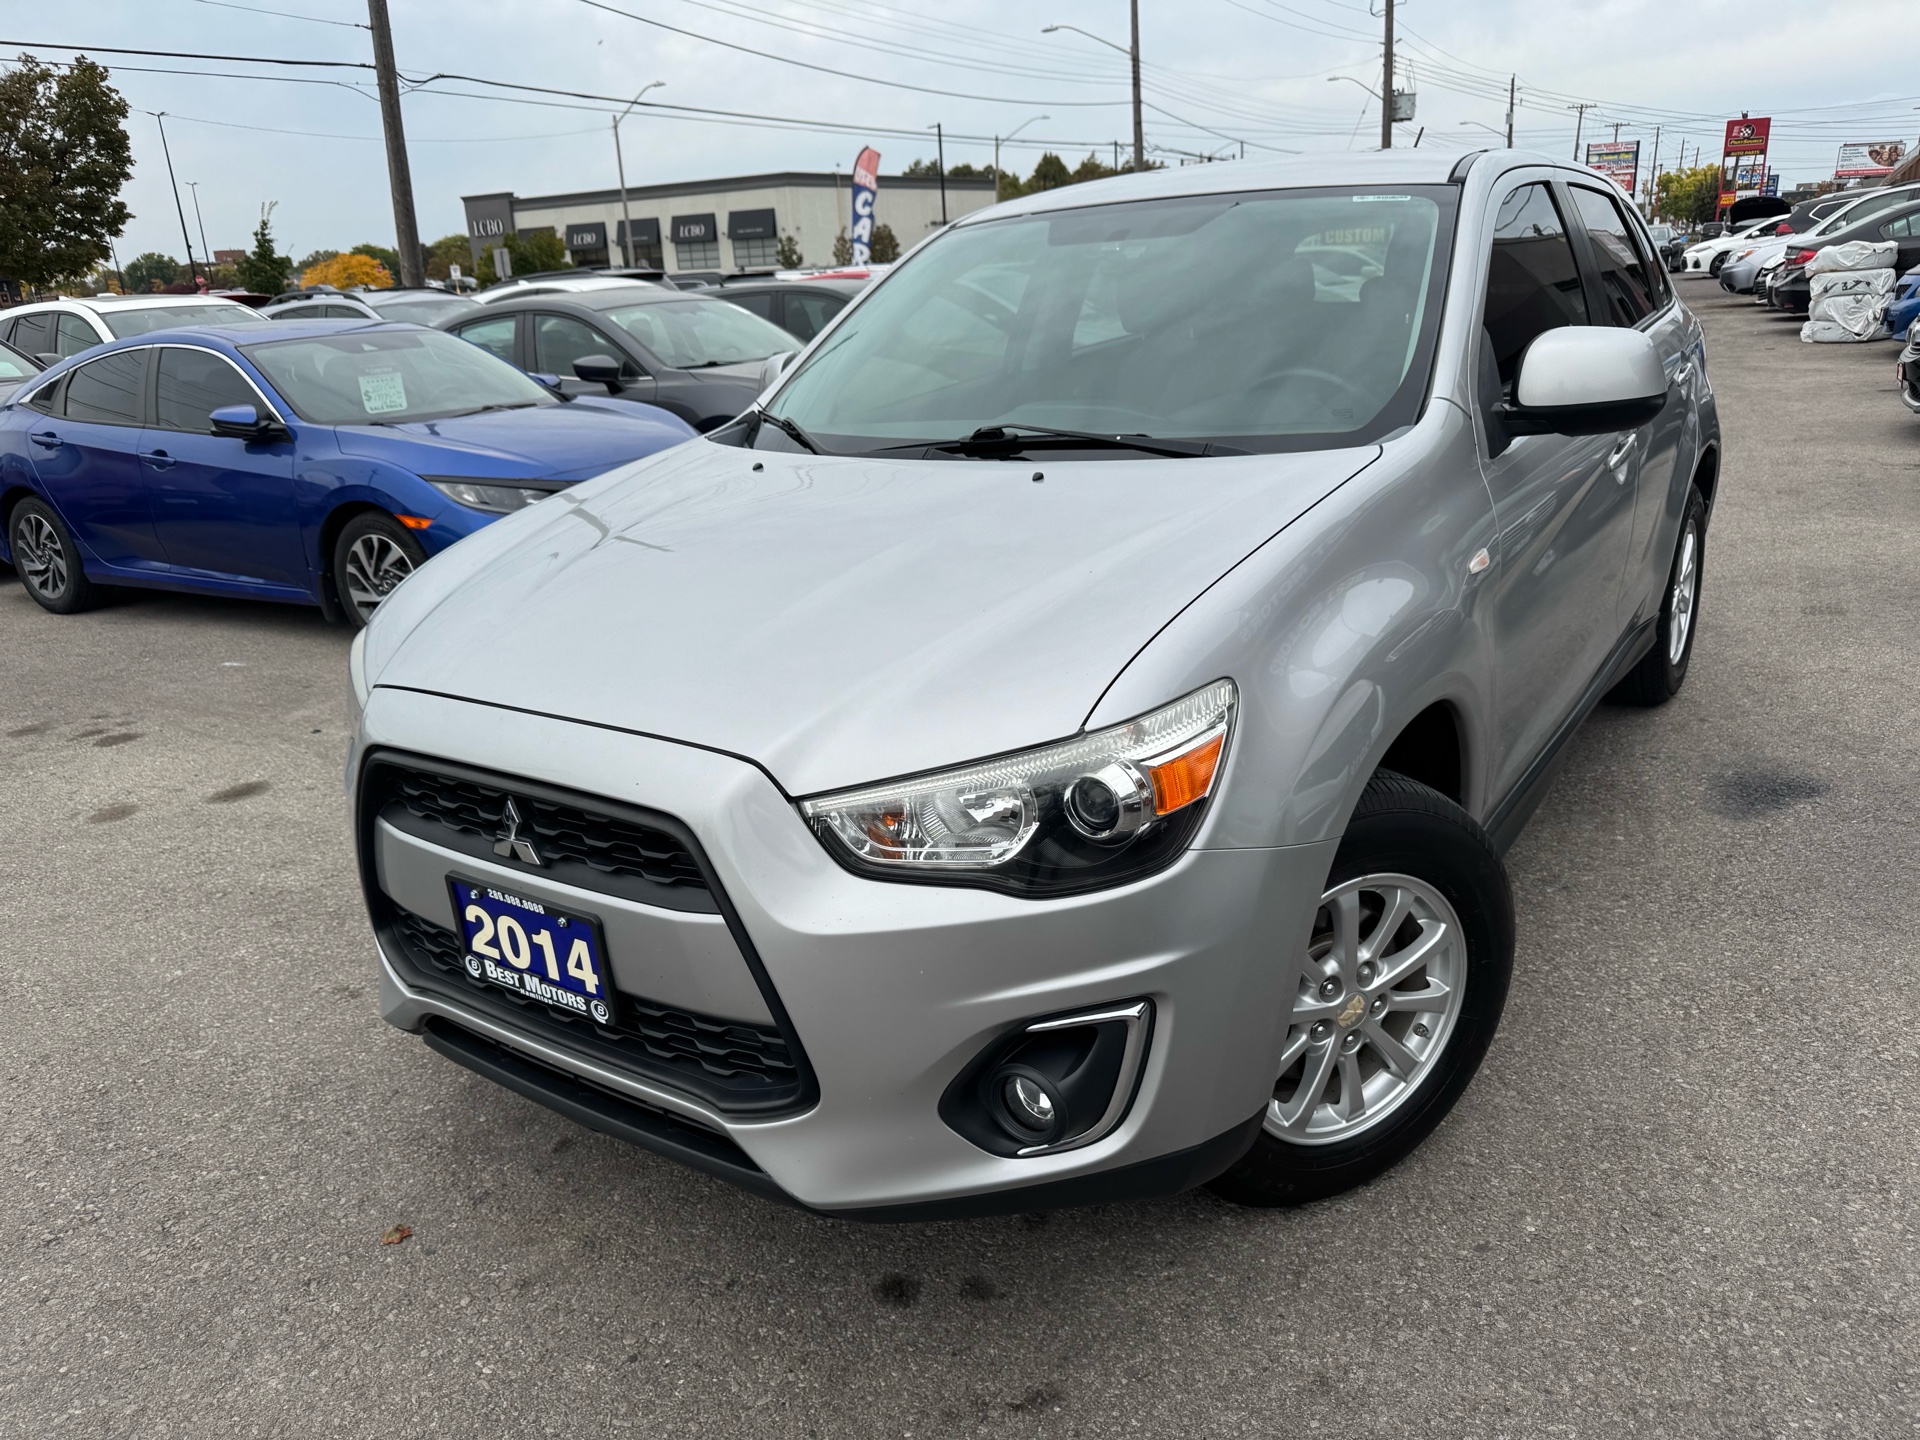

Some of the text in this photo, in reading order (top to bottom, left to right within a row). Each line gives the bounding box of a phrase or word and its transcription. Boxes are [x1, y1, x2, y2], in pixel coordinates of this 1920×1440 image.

[473, 218, 504, 238] LCBO
[679, 224, 705, 238] LCBO
[1325, 228, 1385, 244] CUSTOM
[573, 232, 597, 246] LCBO
[465, 904, 600, 995] 2014
